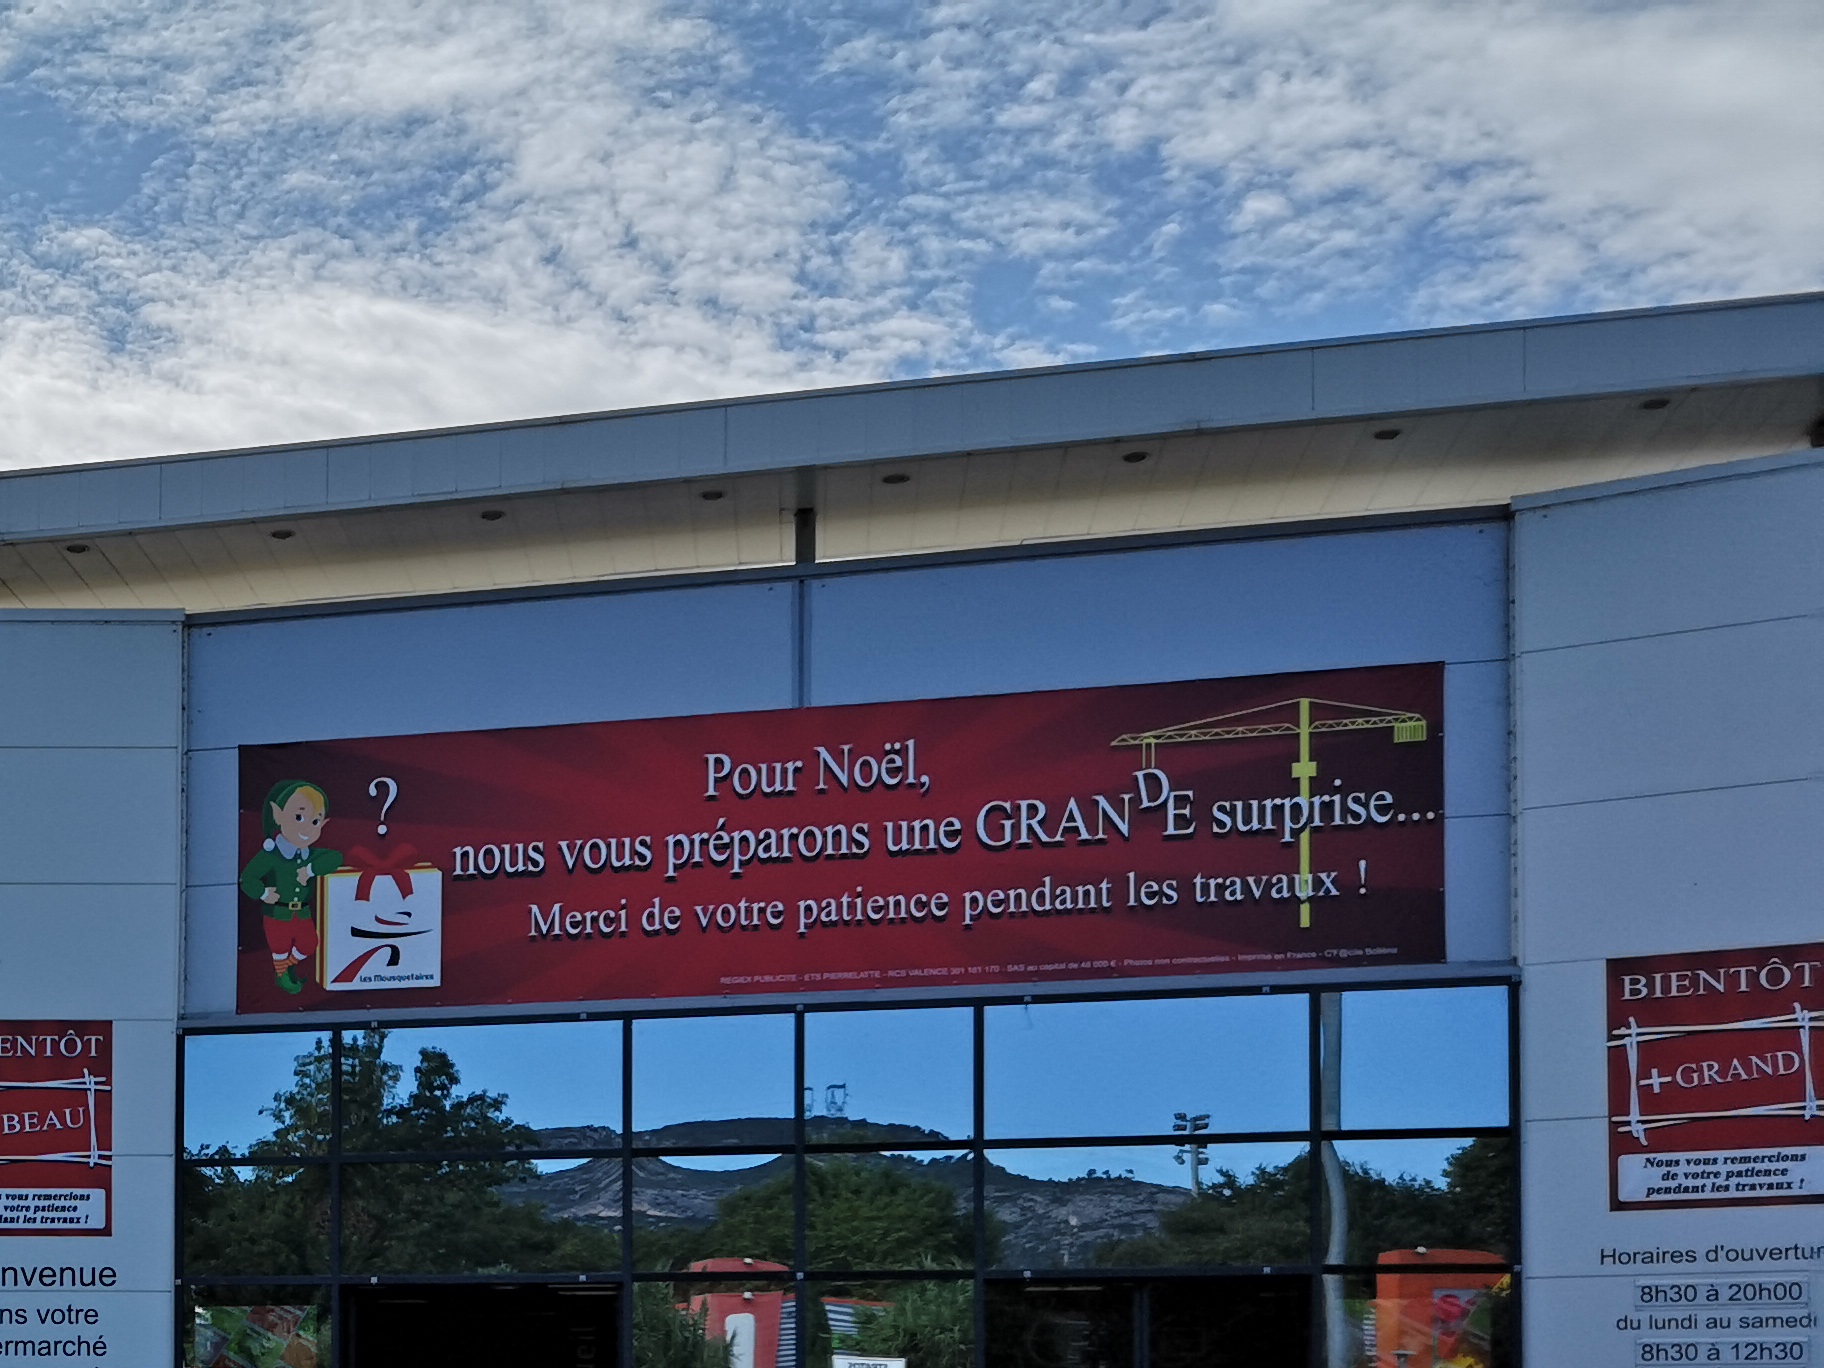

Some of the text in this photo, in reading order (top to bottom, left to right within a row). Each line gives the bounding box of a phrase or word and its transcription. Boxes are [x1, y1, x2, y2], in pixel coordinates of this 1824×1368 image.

[704, 738, 930, 798] Pour Noël,
[452, 768, 1436, 877] nous vous préparons une GRANDE surprise...
[529, 898, 629, 938] Merci
[642, 897, 682, 932] de
[694, 894, 784, 929] votre
[797, 886, 949, 933] patience
[963, 875, 1112, 926] pendant
[1126, 870, 1179, 907] les
[1192, 867, 1341, 902] travaux
[1620, 957, 1822, 1001] BIENTÔT
[1643, 1151, 1807, 1169] Nous vous remercions
[1661, 1166, 1789, 1182] de votre patience
[5, 1192, 29, 1202] vous
[31, 1191, 91, 1202] remercions
[1645, 1183, 1707, 1198] pendant
[1710, 1181, 1730, 1193] les
[1734, 1179, 1794, 1192] travaux
[3, 1203, 31, 1213] votre
[33, 1203, 78, 1216] patience
[22, 1215, 38, 1224] les
[40, 1215, 82, 1225] travaux
[1600, 1246, 1698, 1266] Horaires
[1639, 1281, 1803, 1304] 8h30 à 20h00
[36, 1303, 99, 1325] votre
[1615, 1312, 1818, 1331] du lundi au samedi
[1639, 1341, 1804, 1362] 8h30 à 12h30
